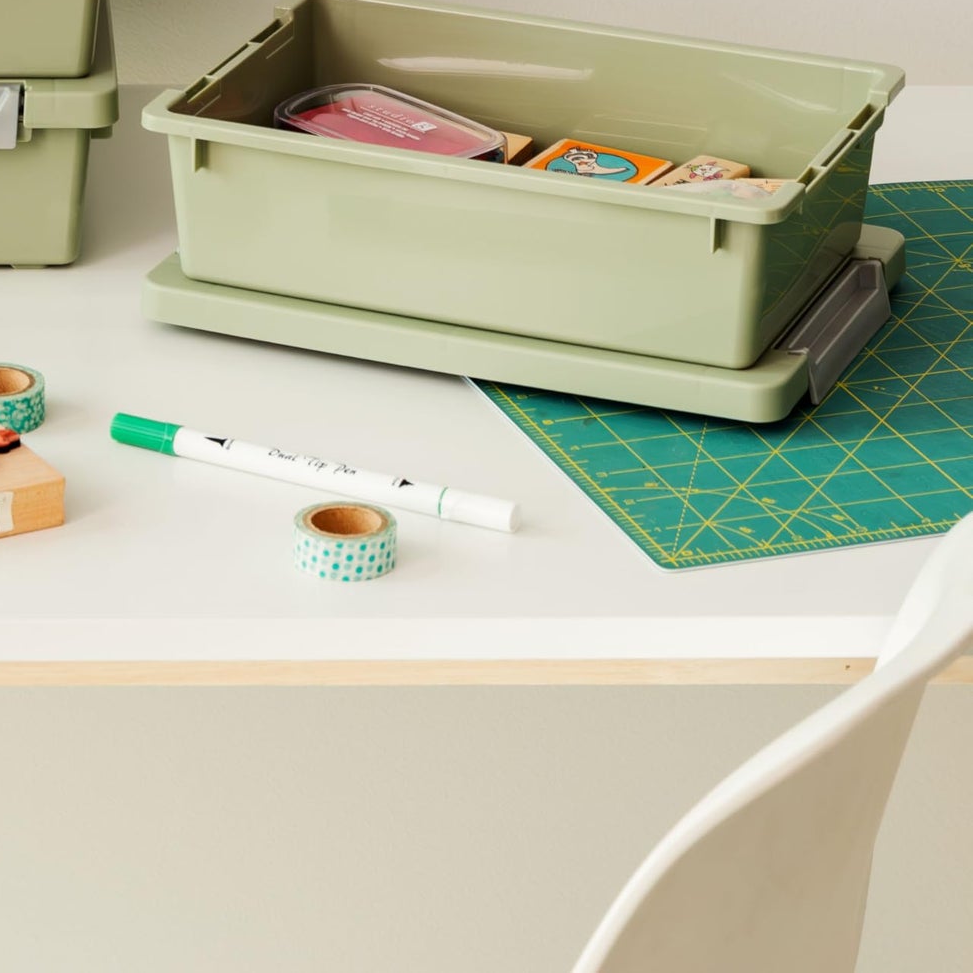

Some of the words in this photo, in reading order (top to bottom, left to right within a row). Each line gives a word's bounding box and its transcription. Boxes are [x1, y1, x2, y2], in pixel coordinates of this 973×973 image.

[268, 447, 299, 461] Dual
[304, 454, 328, 472] Tip
[333, 461, 357, 475] Pen
